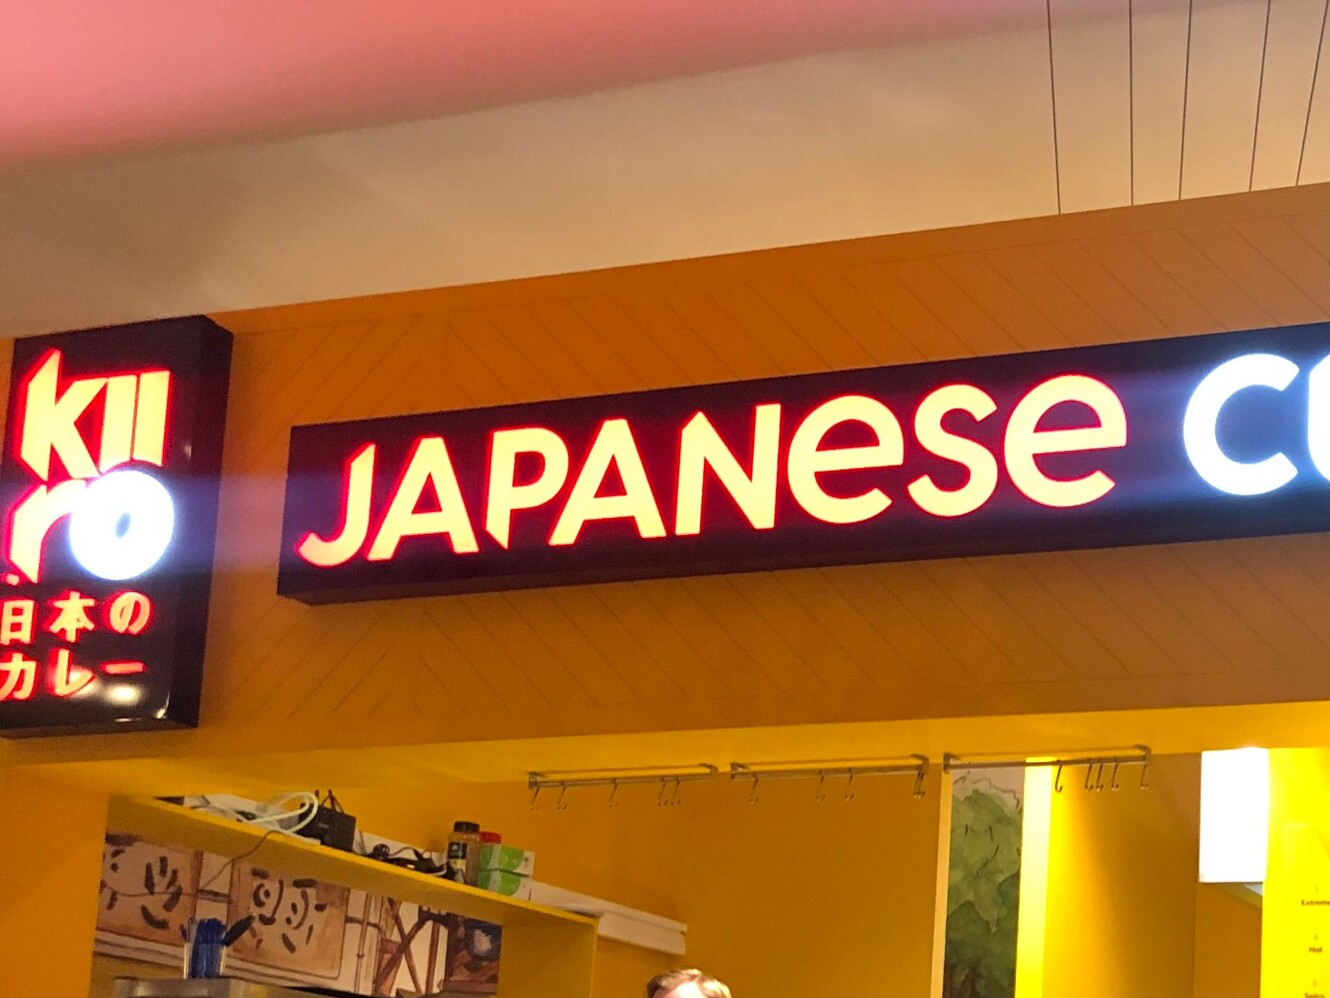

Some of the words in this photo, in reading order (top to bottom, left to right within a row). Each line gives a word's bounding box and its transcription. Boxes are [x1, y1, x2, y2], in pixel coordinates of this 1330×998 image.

[0, 590, 151, 645] 日本の
[0, 648, 146, 700] カレー
